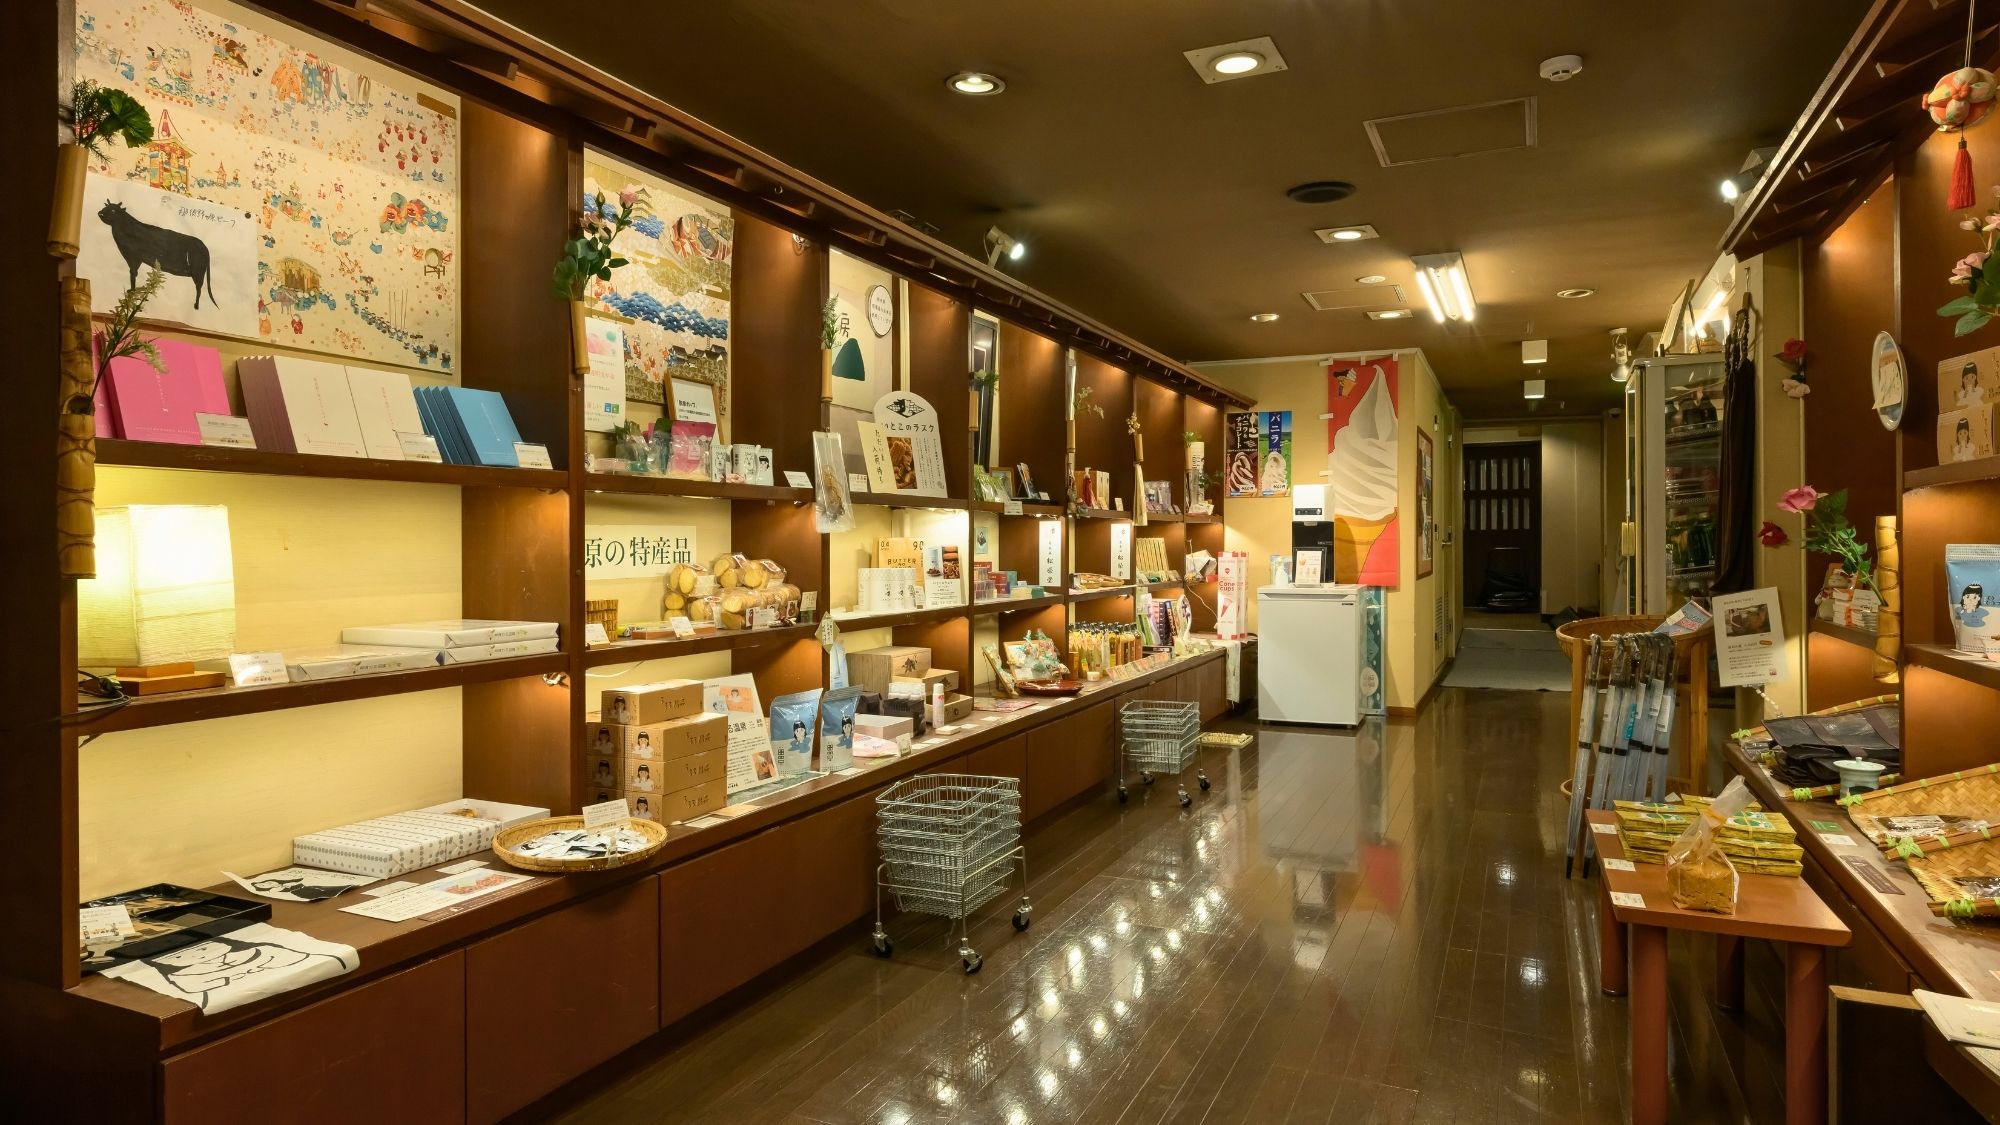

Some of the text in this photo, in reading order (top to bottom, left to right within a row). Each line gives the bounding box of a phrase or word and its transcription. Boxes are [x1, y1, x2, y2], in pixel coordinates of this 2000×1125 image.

[1270, 414, 1281, 444] バニラ
[585, 536, 692, 568] 原の特産品
[887, 558, 917, 566] BUTTER
